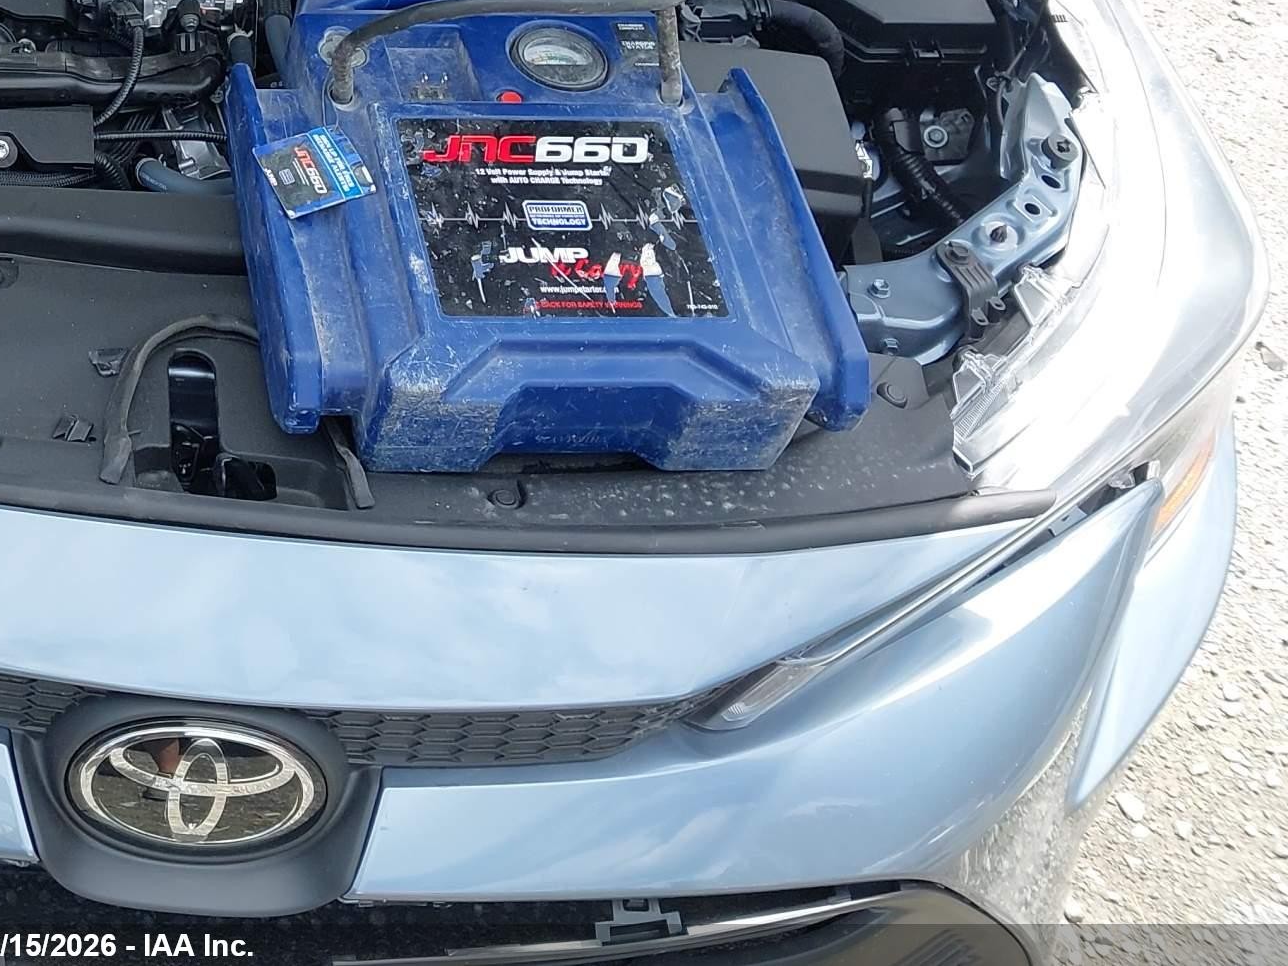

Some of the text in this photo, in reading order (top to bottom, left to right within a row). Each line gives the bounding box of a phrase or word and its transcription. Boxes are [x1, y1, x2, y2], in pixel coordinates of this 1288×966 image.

[422, 135, 649, 163] JNC660
[294, 147, 328, 194] JNC660
[486, 168, 502, 176] Volt
[502, 168, 526, 176] Power
[527, 168, 554, 177] Supply
[561, 169, 584, 177] Jump
[490, 176, 508, 184] with
[530, 177, 560, 185] CHARGE
[561, 177, 603, 186] Technology
[531, 217, 586, 226] TECHNOLOGY
[499, 246, 589, 264] JUMP
